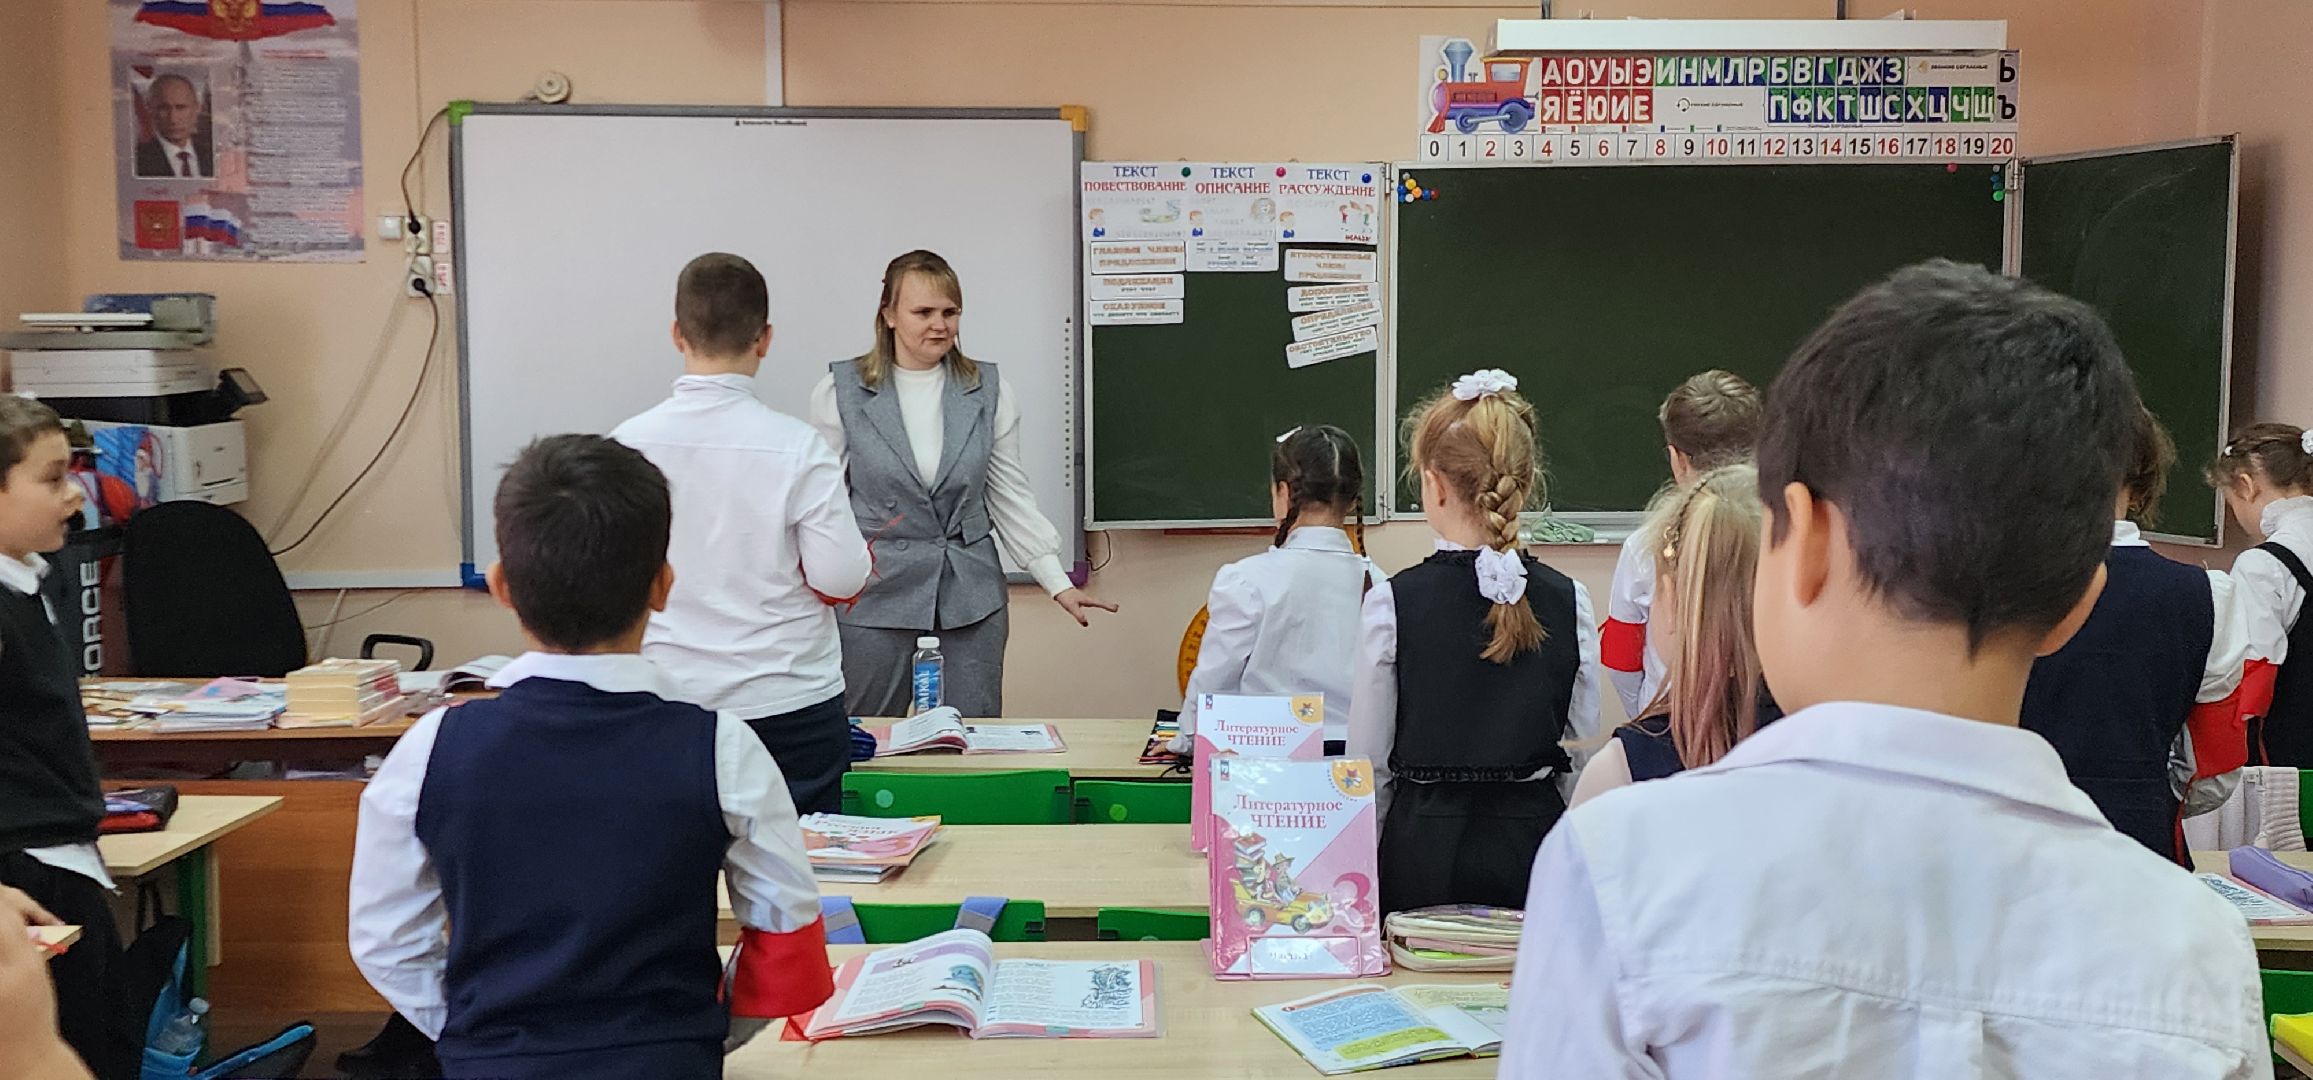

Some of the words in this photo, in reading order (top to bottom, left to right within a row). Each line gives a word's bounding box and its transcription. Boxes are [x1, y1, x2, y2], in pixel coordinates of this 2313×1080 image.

[1429, 141, 1439, 157] 0
[1459, 141, 1466, 157] 1
[1486, 141, 1496, 157] 2
[1514, 141, 1523, 157] 3
[1542, 140, 1552, 156] 4
[1570, 140, 1580, 156] 5
[1599, 140, 1608, 156] 6
[1627, 140, 1637, 156] 7
[1656, 140, 1665, 156] 8
[1684, 140, 1694, 156] 9
[1708, 140, 1727, 156] 10
[1737, 140, 1754, 156] 11
[1764, 140, 1785, 156] 12
[1792, 138, 1813, 154] 13
[1821, 138, 1841, 154] 14
[1850, 138, 1870, 154] 15
[1878, 138, 1899, 154] 16
[1906, 138, 1927, 154] 17
[1935, 138, 1956, 154] 18
[1964, 138, 1984, 154] 19
[1992, 138, 2013, 154] 20
[1113, 166, 1158, 177] ТЕКСТ
[1211, 167, 1255, 178] ТЕКСТ
[1307, 169, 1350, 180] ТЕКСТ
[1085, 181, 1186, 191] ПОВЕСТВОВАНИЕ
[1195, 182, 1270, 194] ОПИСАНИЕ
[1279, 184, 1376, 197] РАССУЖДЕНИЕ
[79, 560, 104, 677] ORCE
[1214, 719, 1299, 735] Литературное
[1227, 734, 1286, 746] ЧТЕНИЕ
[1233, 794, 1343, 814] Литературное
[1251, 814, 1327, 829] ЧТЕНИЕ
